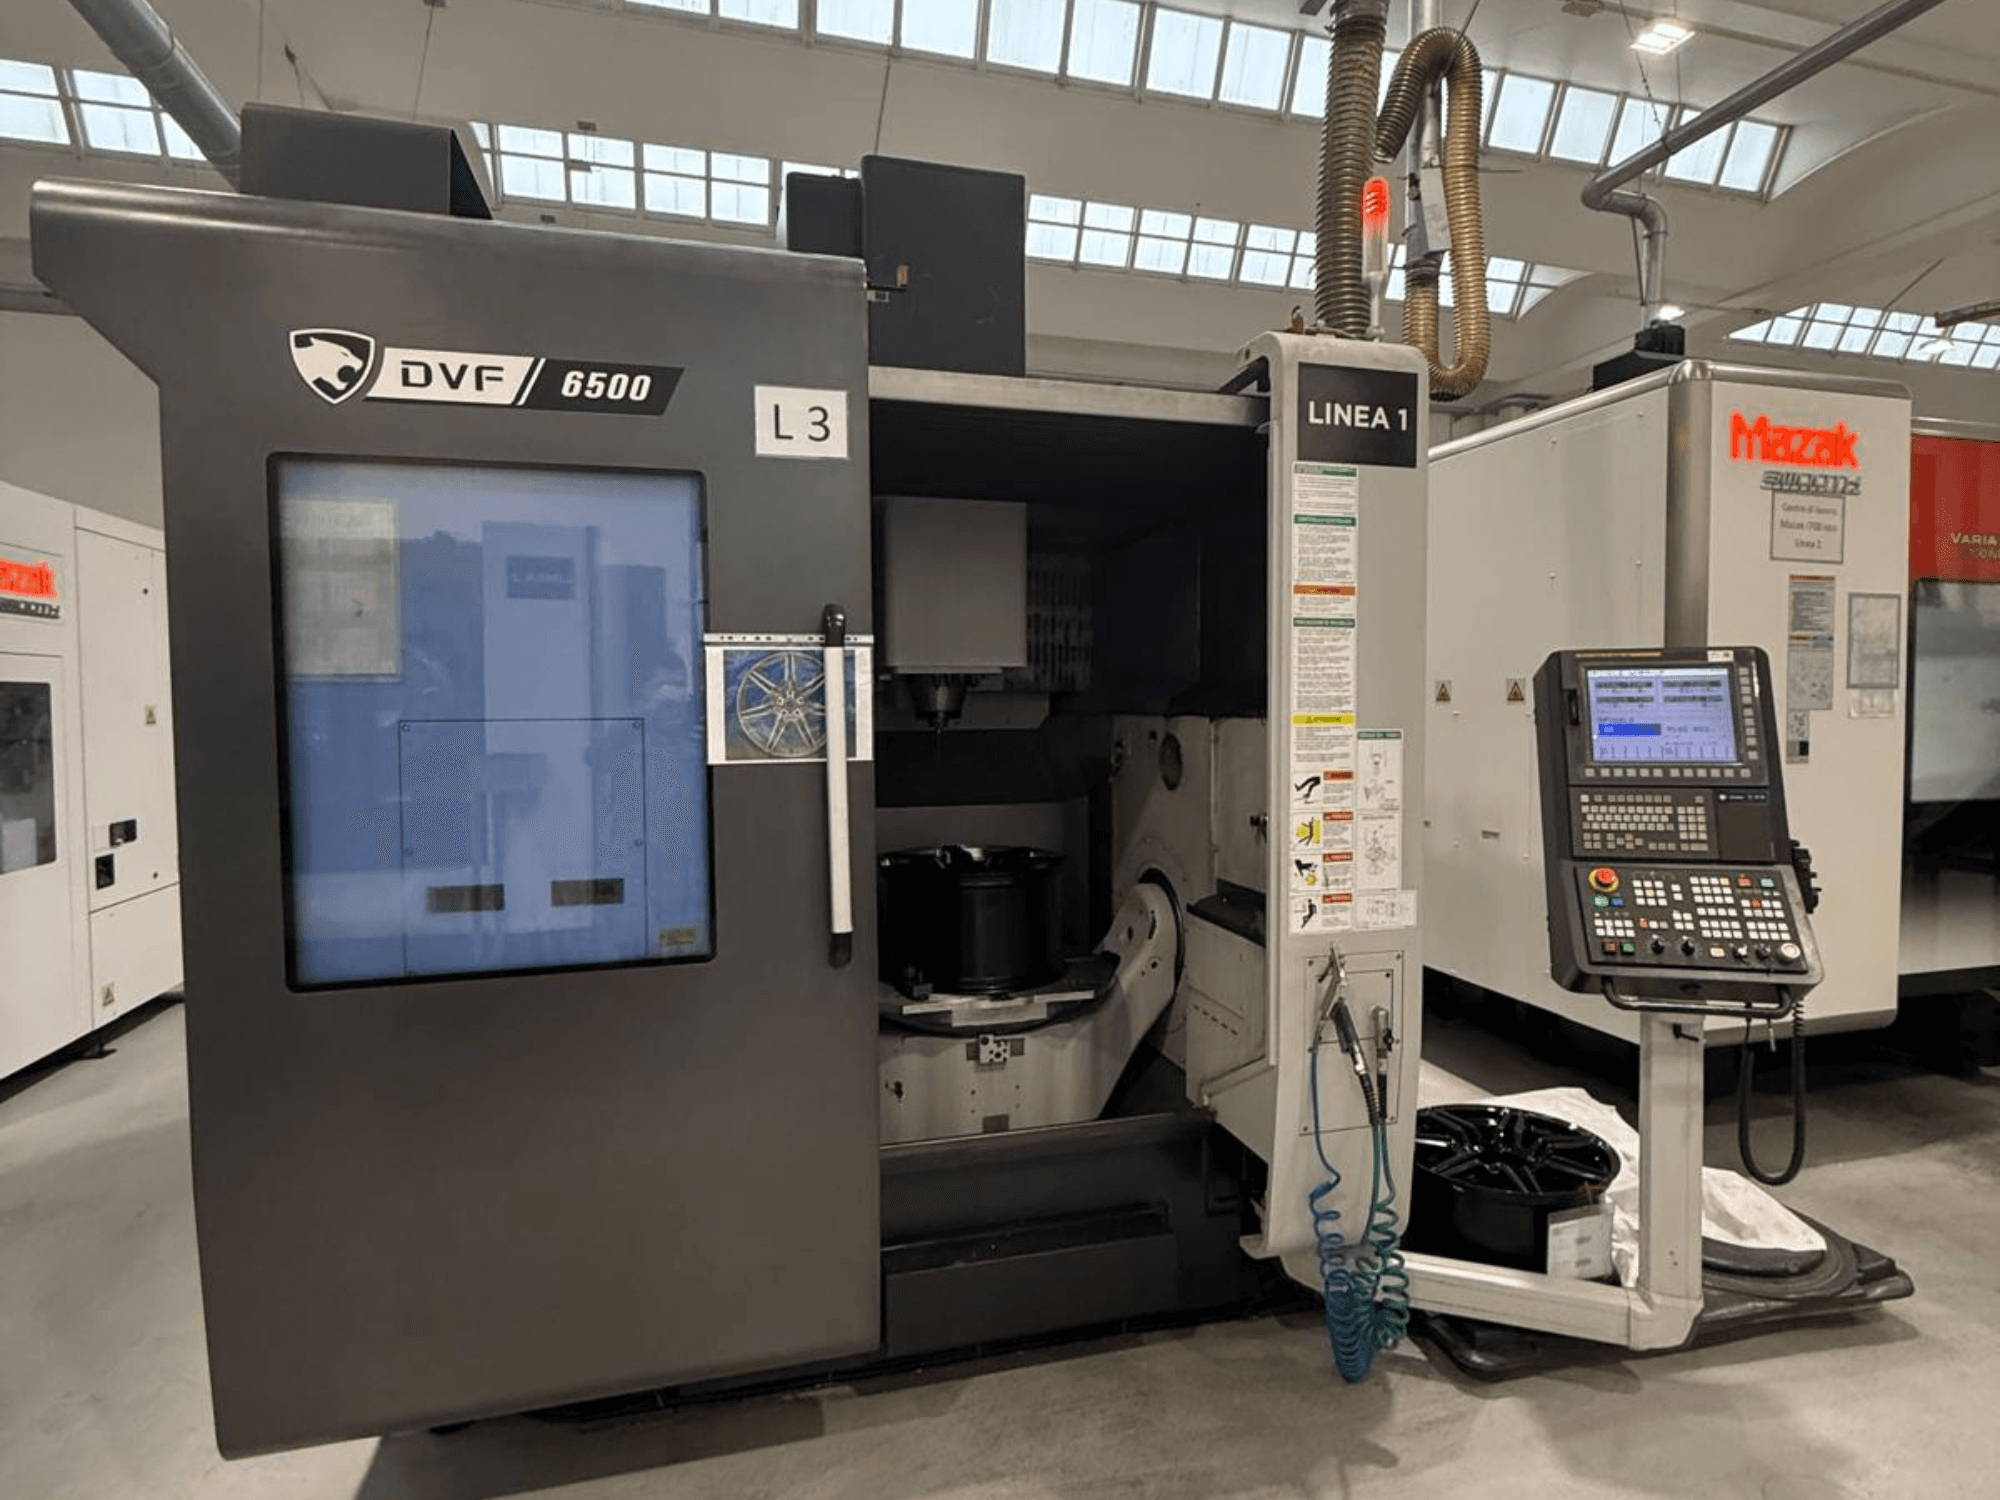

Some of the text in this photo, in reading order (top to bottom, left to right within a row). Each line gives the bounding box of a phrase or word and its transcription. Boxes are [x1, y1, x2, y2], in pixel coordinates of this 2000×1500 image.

[401, 359, 652, 401] DVF 6500
[774, 403, 830, 442] L 3
[1308, 400, 1408, 431] LINEA 1
[1731, 412, 1861, 468] Mazak
